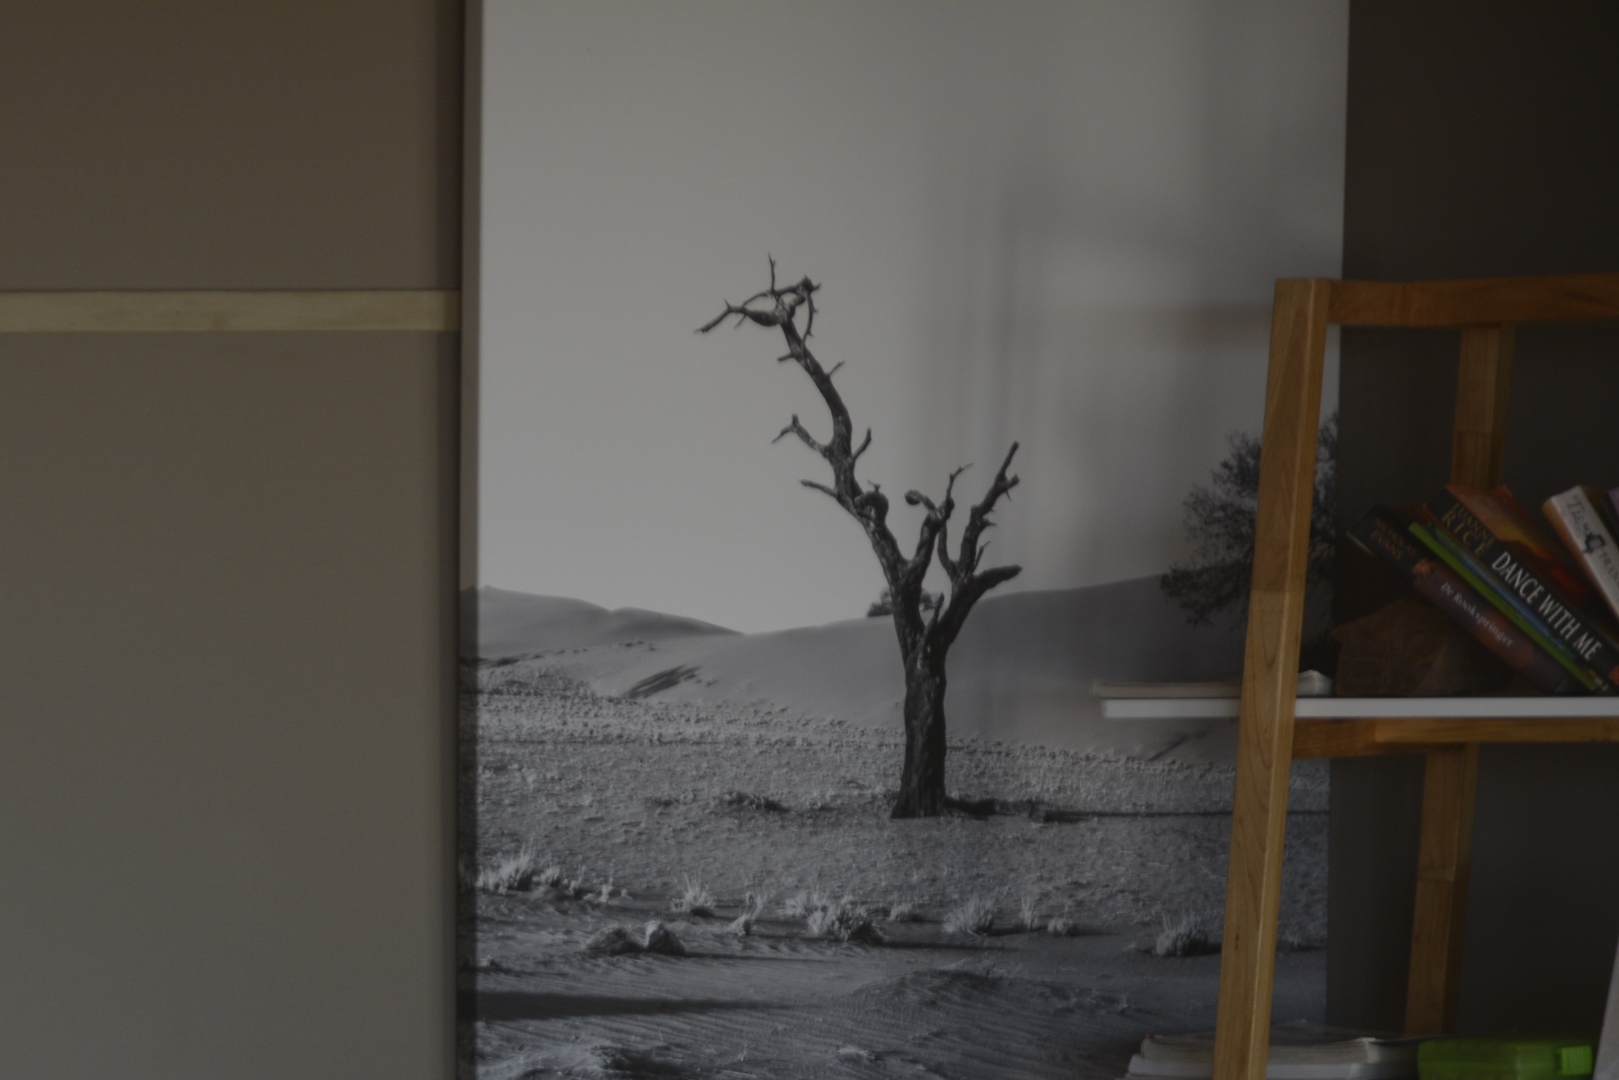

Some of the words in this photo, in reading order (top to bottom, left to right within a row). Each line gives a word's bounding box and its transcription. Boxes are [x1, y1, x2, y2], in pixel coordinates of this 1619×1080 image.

[1371, 529, 1403, 560] EVANS
[1442, 510, 1487, 555] RICE
[1491, 551, 1545, 605] DANCE
[1538, 594, 1582, 641] WITH
[1573, 631, 1603, 661] ME
